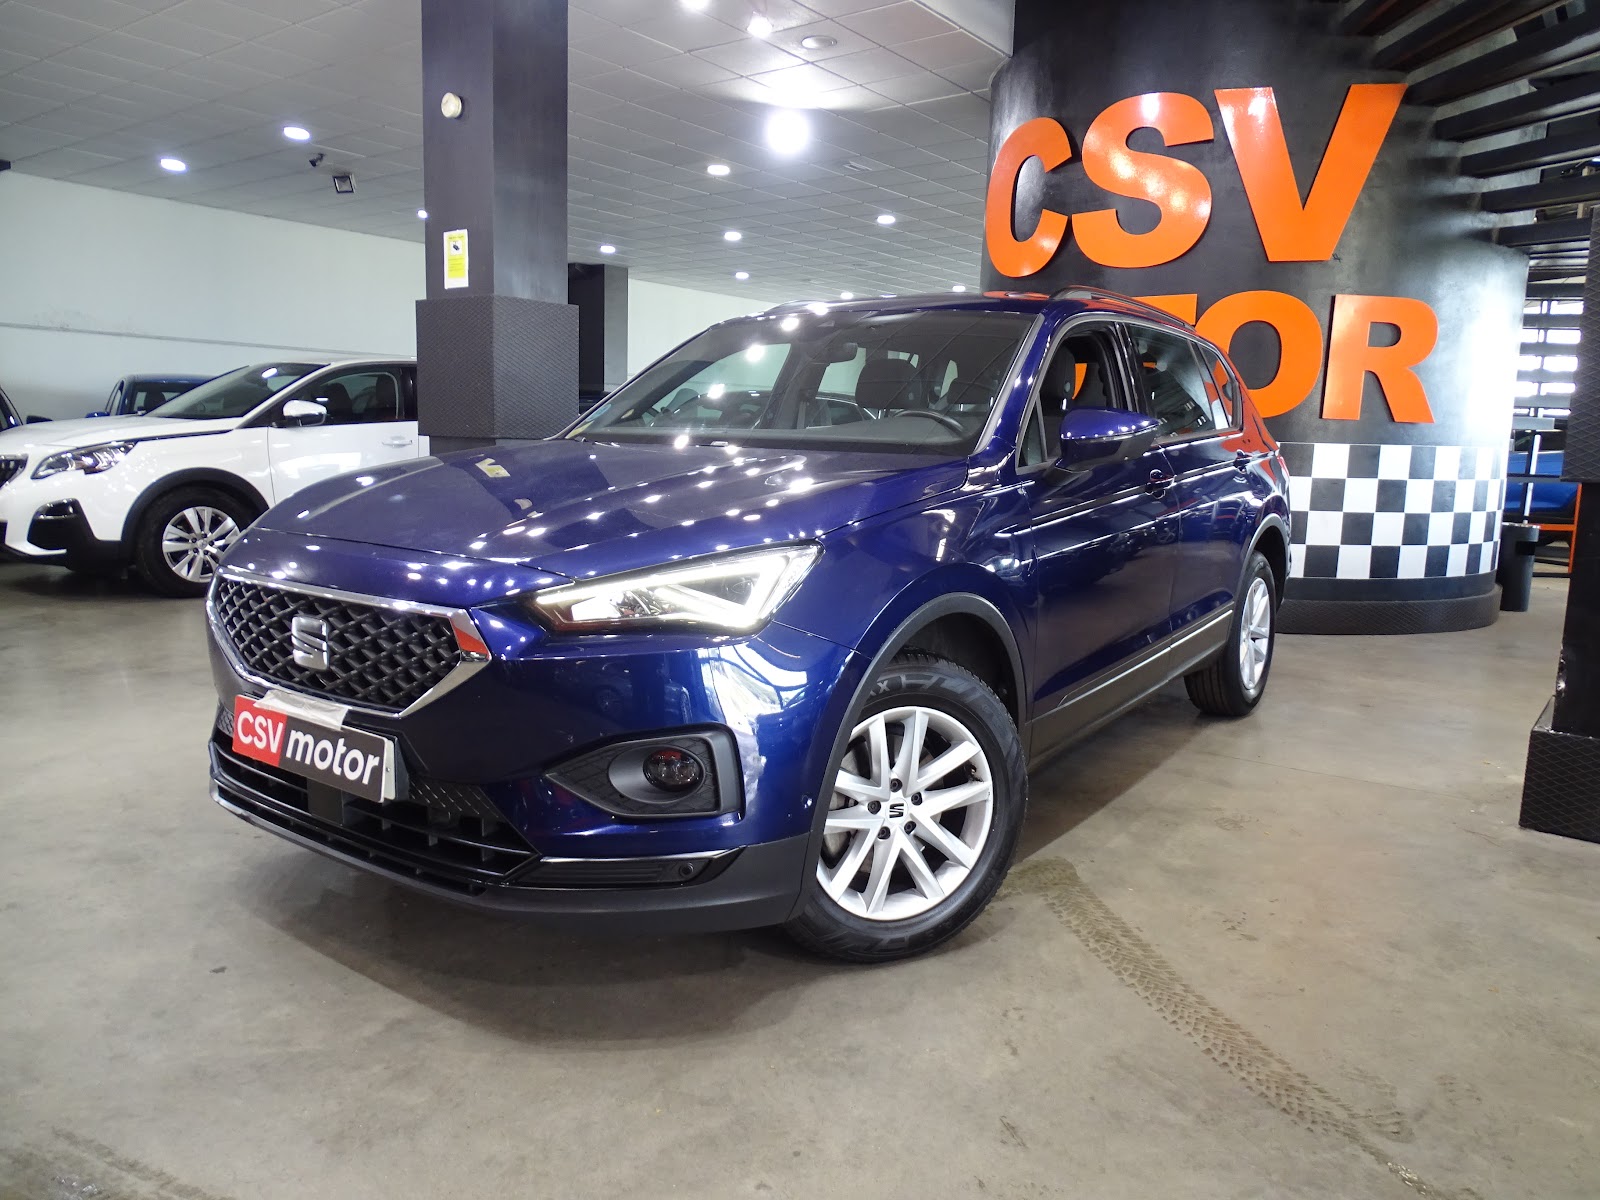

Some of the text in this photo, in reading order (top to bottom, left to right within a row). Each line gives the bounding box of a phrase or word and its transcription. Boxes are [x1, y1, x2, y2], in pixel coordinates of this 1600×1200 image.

[986, 83, 1408, 278] CSV
[237, 710, 380, 785] CSV motor
